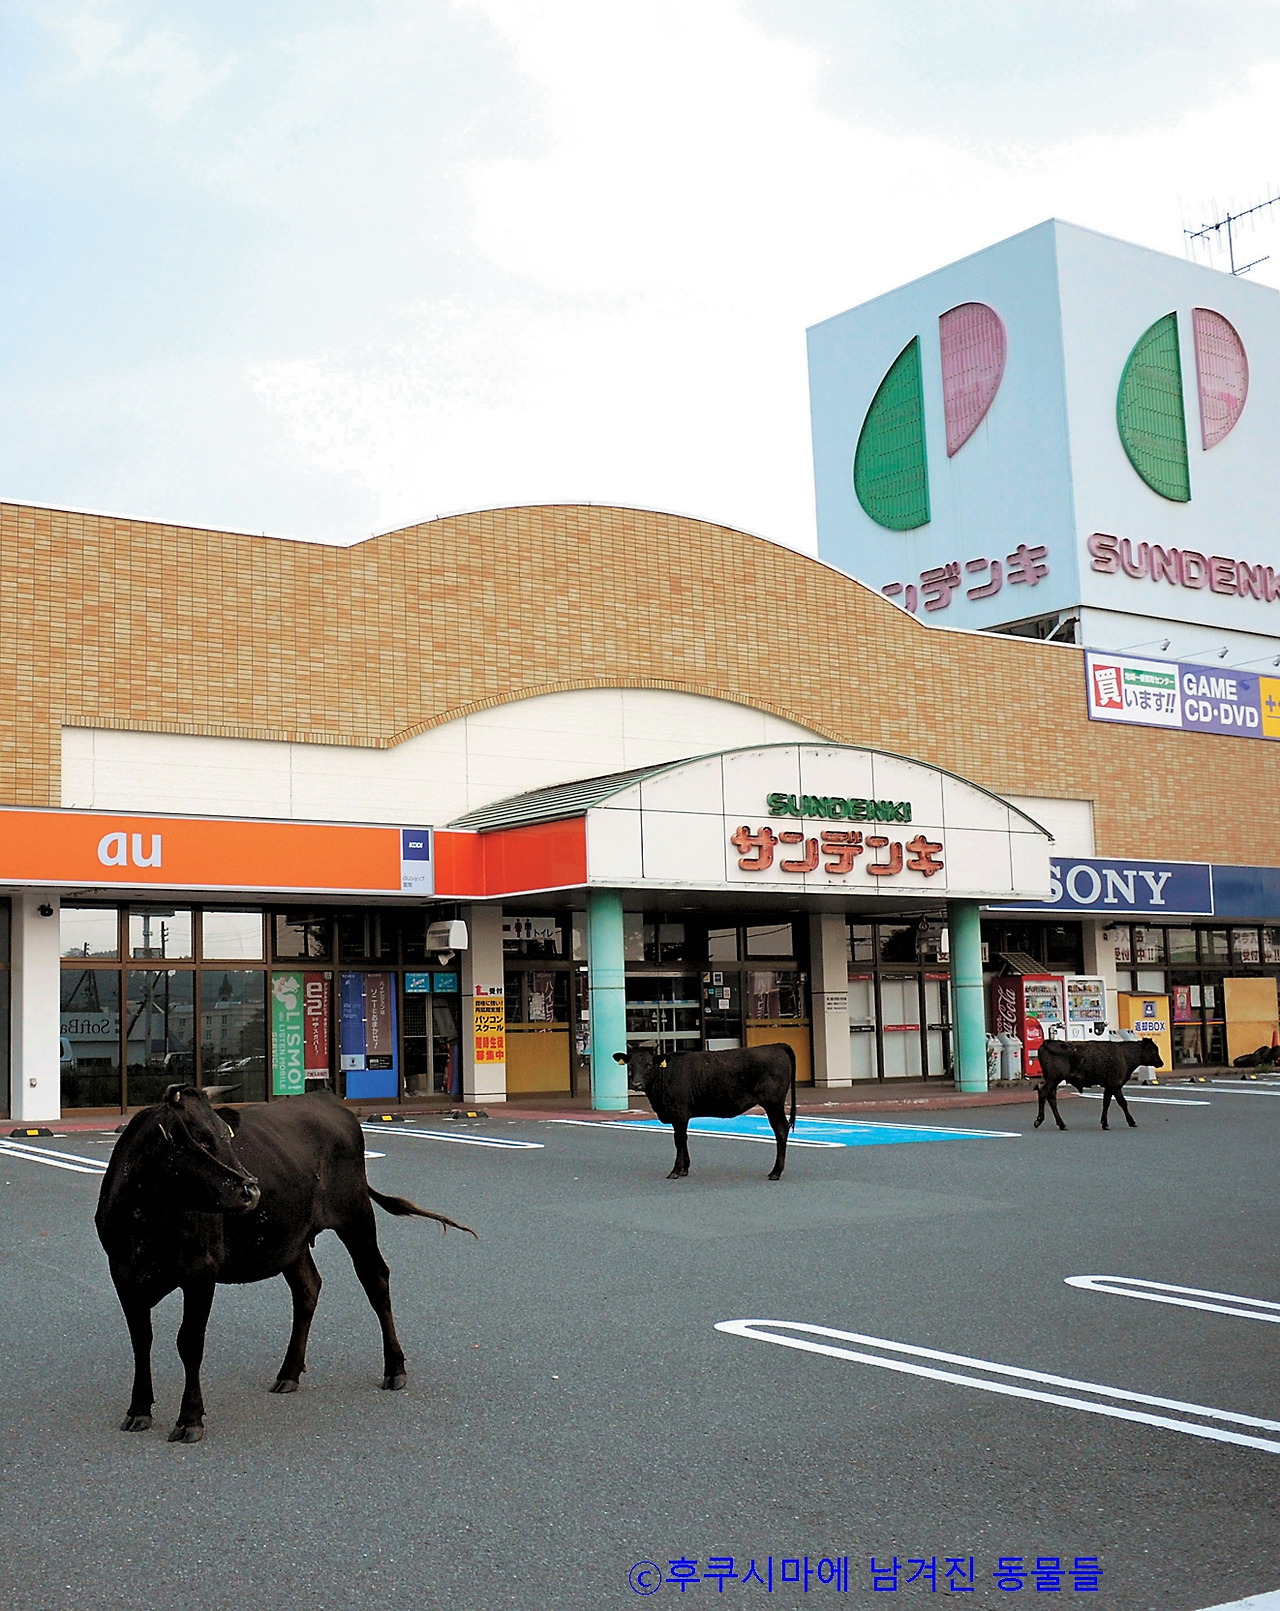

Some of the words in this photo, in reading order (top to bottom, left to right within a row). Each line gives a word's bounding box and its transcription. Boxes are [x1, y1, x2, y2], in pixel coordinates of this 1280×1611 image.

[1183, 673, 1238, 701] GAME
[766, 792, 912, 823] SUNDENKI
[97, 831, 162, 868] au
[731, 825, 945, 878] サンデンキ
[1043, 864, 1172, 905] SONY
[534, 928, 554, 938] トイレ
[489, 987, 503, 995] 受付
[475, 1015, 504, 1024] パソコン
[475, 1024, 504, 1033] スクール
[1134, 1021, 1166, 1032] 返却BOX
[278, 1024, 286, 1055] LISTEN
[286, 1011, 302, 1091] LISMO!
[279, 1057, 287, 1090] MOBILE
